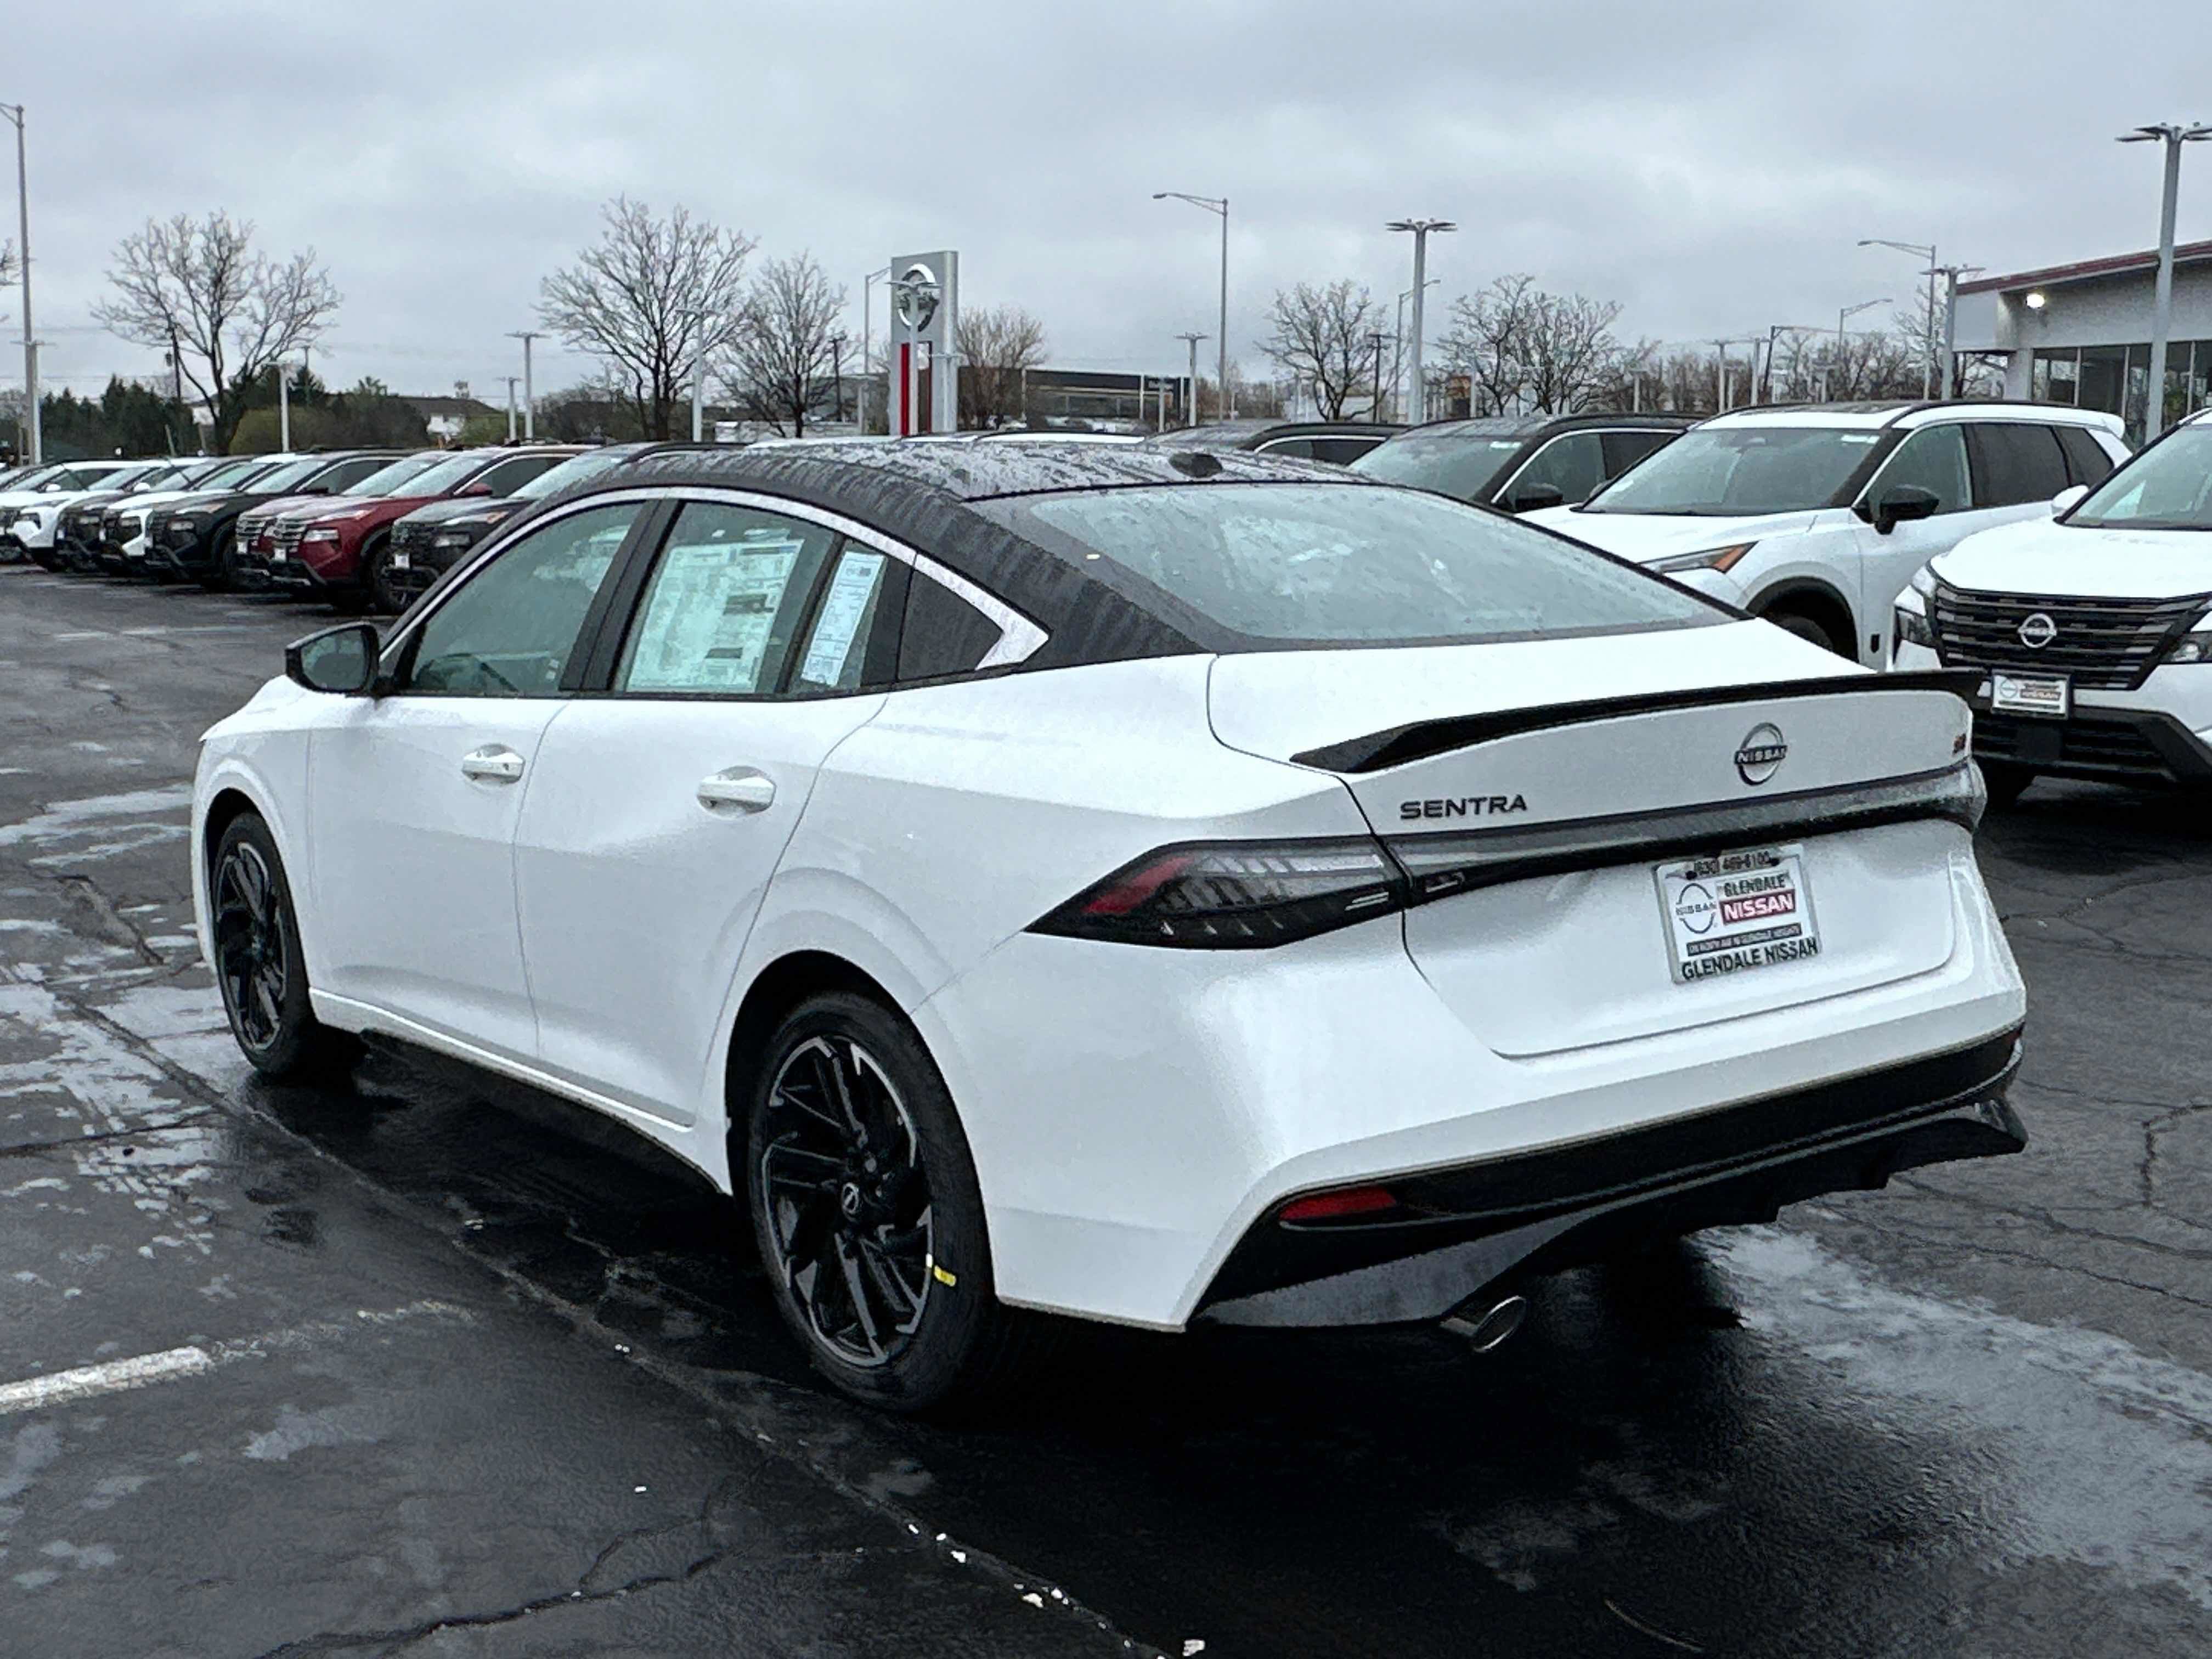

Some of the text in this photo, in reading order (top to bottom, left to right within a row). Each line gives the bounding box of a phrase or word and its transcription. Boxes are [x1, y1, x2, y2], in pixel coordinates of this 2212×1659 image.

[1736, 747, 1787, 763] NISSAN
[1400, 794, 1527, 820] SENTRA
[1724, 873, 1786, 898] GLENDALE
[1724, 893, 1793, 921] NISSAN
[1681, 948, 1761, 980] GLENDALE
[1764, 937, 1819, 964] NISSAN
